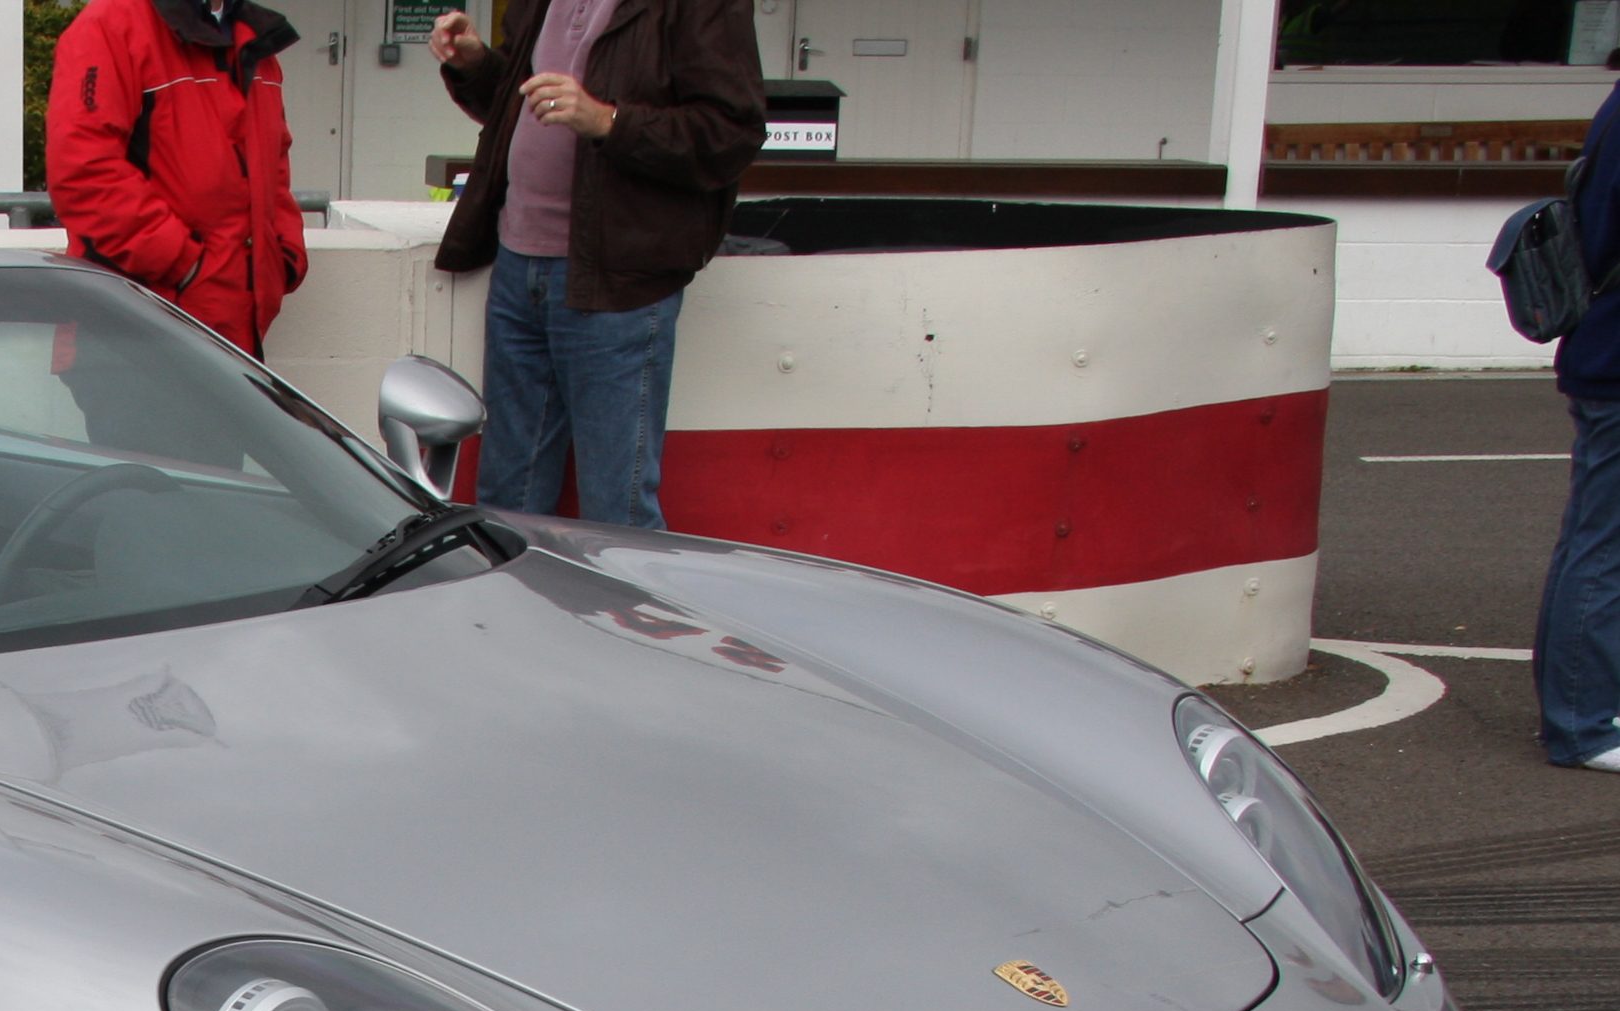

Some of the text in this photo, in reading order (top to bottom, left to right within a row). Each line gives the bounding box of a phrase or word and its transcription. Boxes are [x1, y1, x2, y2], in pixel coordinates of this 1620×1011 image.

[394, 6, 412, 14] First
[413, 6, 428, 14] aid
[428, 6, 441, 14] for
[765, 132, 833, 142] POST BOX
